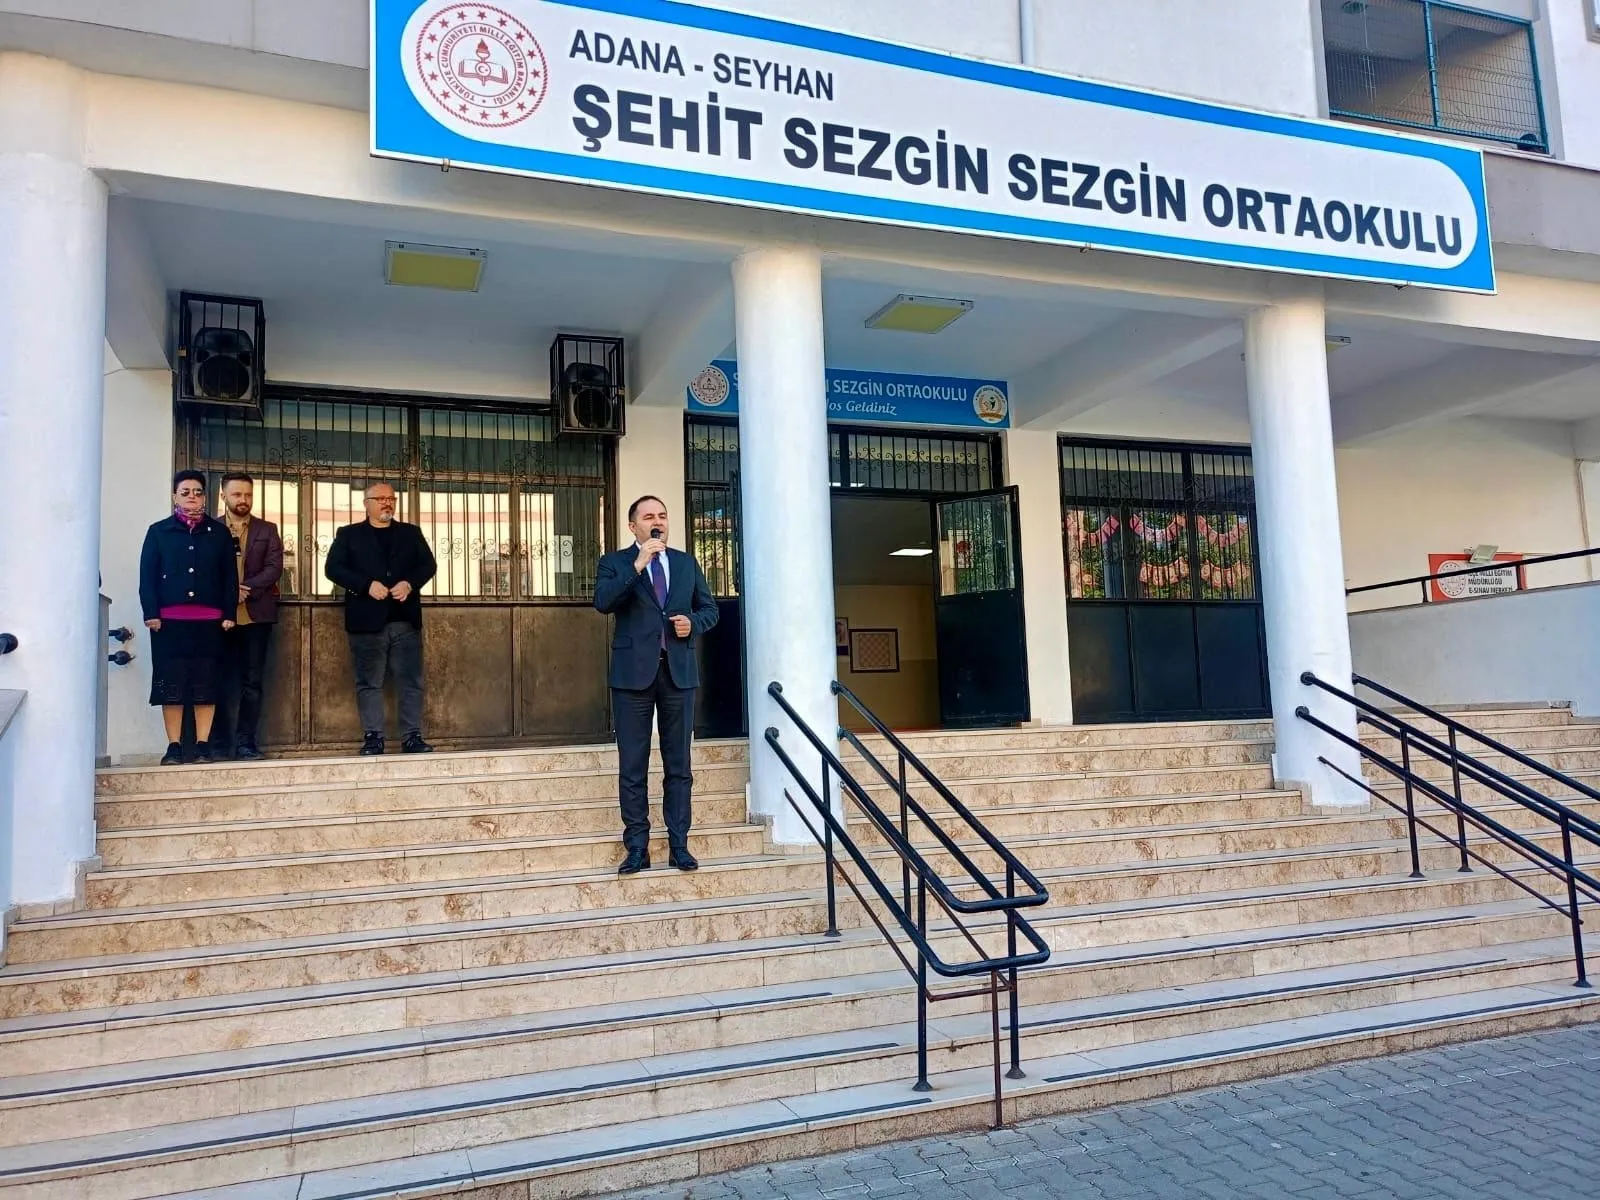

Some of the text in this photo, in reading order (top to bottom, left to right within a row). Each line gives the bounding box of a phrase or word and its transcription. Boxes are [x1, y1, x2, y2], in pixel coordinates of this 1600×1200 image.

[441, 25, 477, 69] CUMHURİYETİ
[479, 26, 505, 40] MİLLİ
[569, 29, 685, 77] ADANA
[713, 53, 834, 101] SEYHAN
[443, 70, 475, 101] TÜRKİYE
[572, 84, 1463, 256] ŞEHİT SEZGİN SEZGİN ORTAOKULU
[833, 379, 883, 396] SEZGİN
[886, 383, 967, 401] ORTAOKULU
[846, 400, 898, 416] Geldiniz
